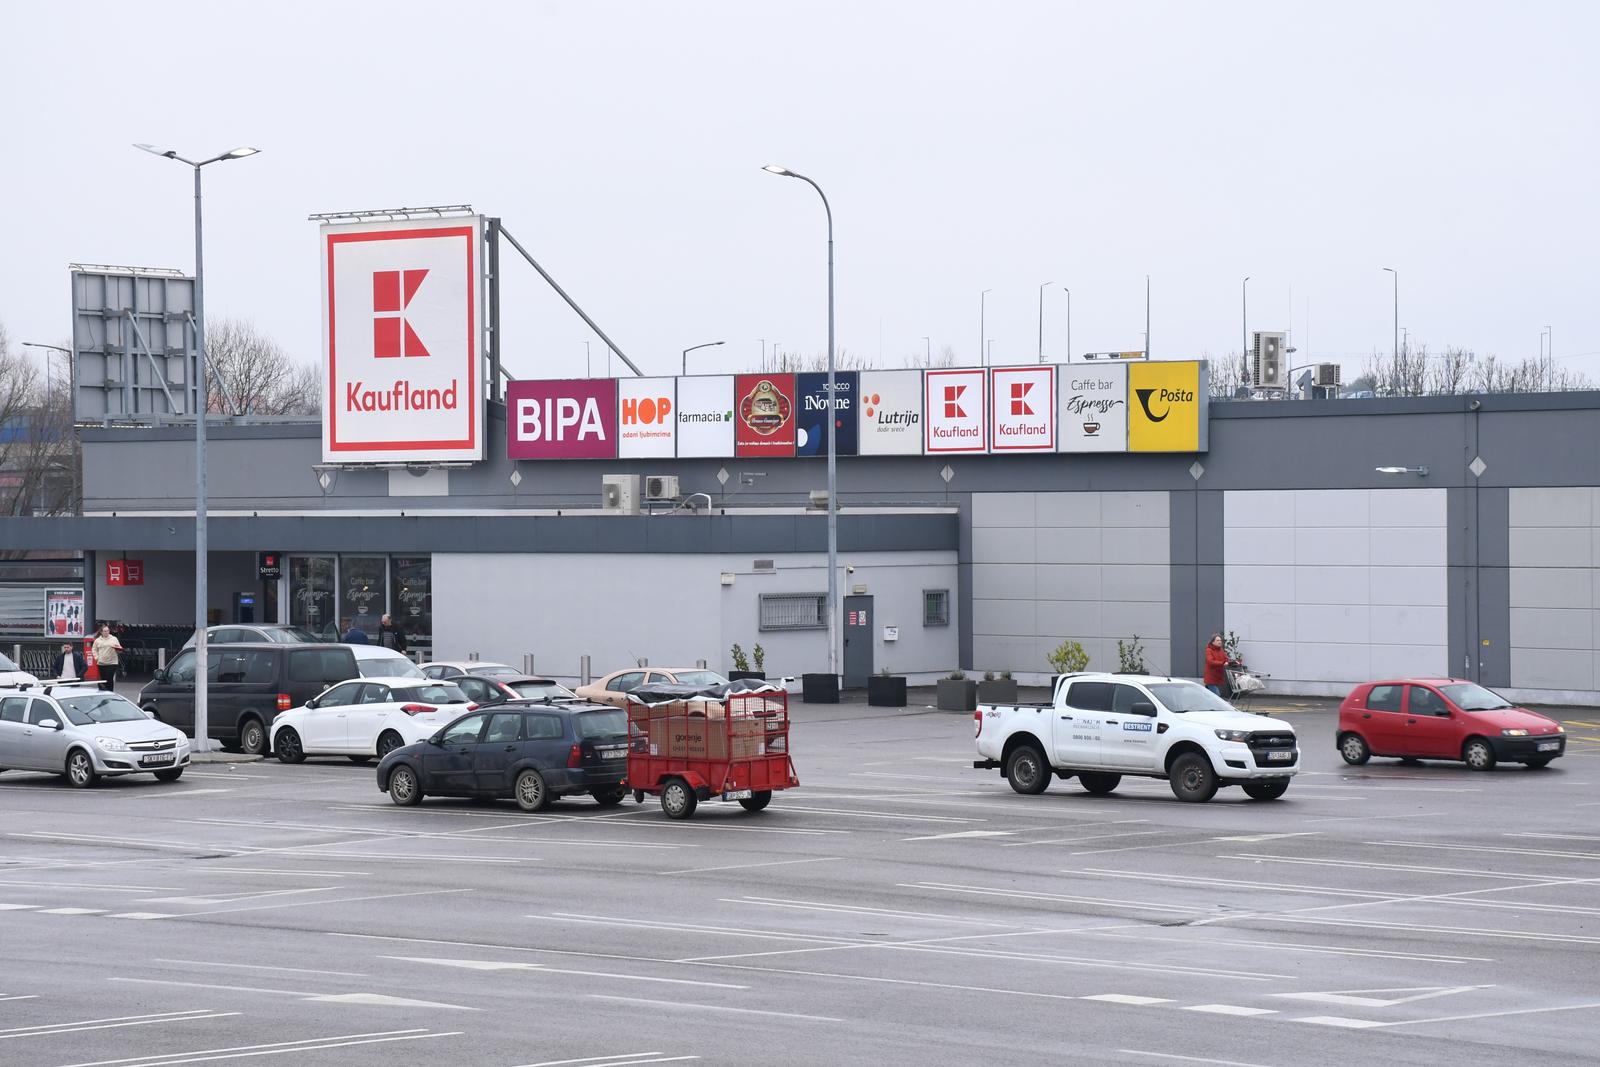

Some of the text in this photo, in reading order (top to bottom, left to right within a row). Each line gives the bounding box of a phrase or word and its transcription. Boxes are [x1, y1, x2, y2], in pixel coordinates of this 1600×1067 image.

[1071, 379, 1114, 391] Caffe bar
[346, 379, 457, 412] Kaufland
[1159, 388, 1194, 402] Pošta
[622, 397, 672, 425] HOP
[1067, 394, 1124, 415] Espresso
[516, 397, 606, 442] BIPA
[679, 411, 722, 423] farmacia
[878, 410, 919, 427] Lutrija
[933, 426, 979, 438] Kaufland
[999, 423, 1046, 435] Kaufland
[1124, 723, 1151, 731] BESTRENT
[675, 733, 702, 743] gorenje
